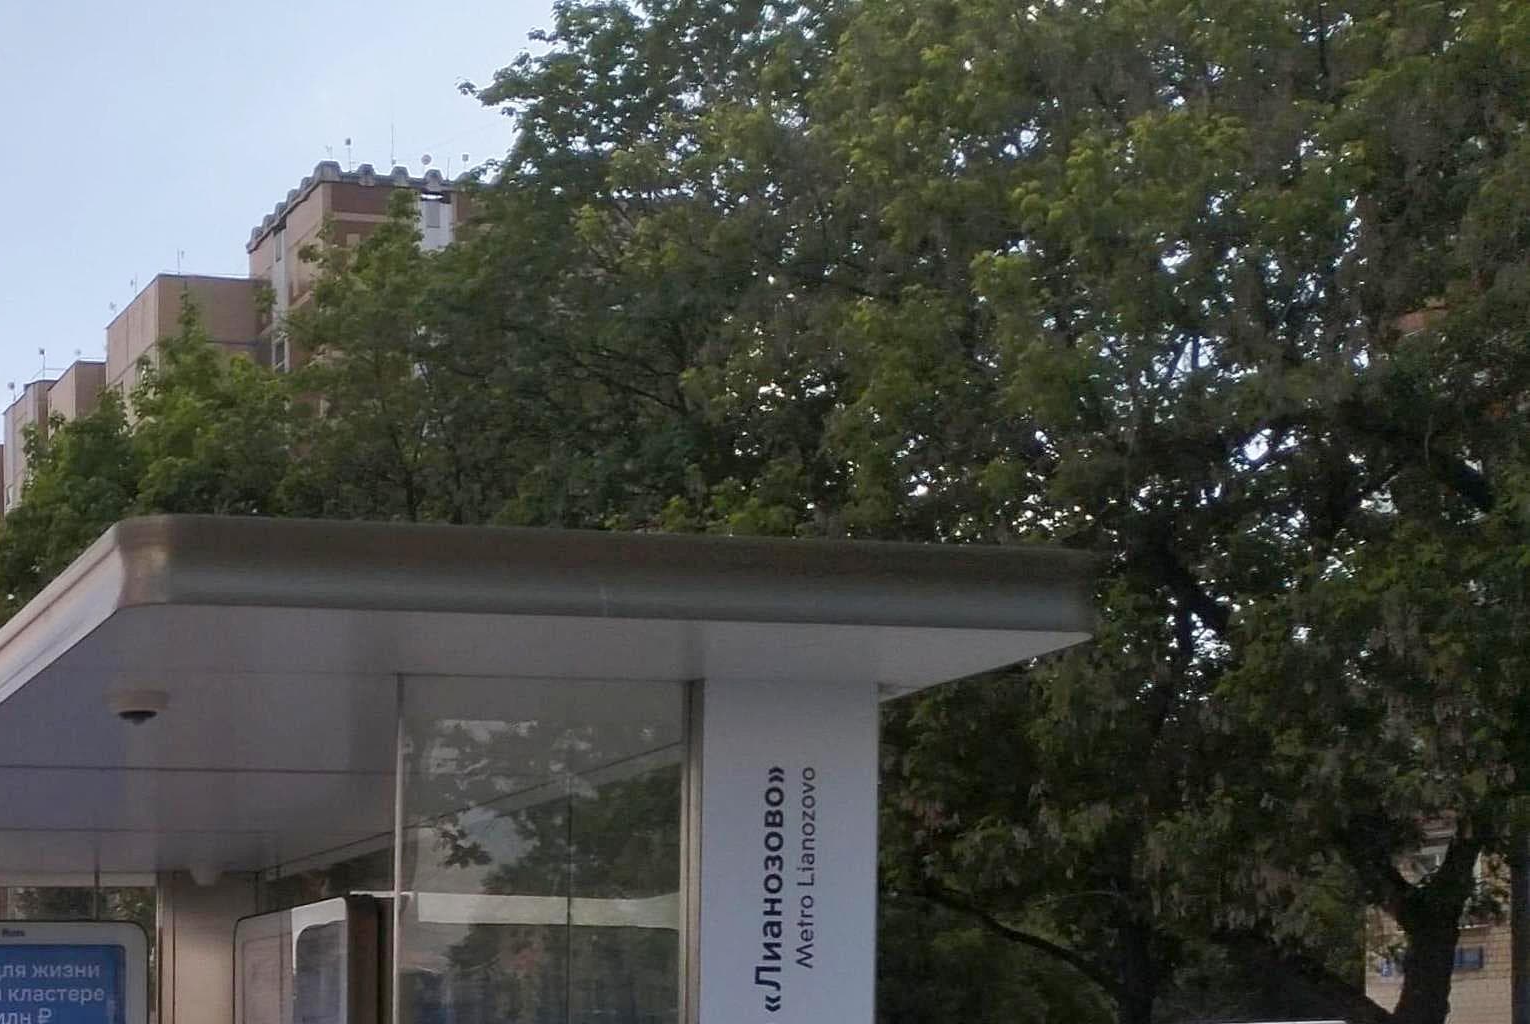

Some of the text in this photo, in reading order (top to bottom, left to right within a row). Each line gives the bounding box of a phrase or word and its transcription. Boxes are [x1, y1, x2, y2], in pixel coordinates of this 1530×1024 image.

[754, 766, 785, 1013] «Лианозово»
[795, 766, 816, 969] Metro Lianozovo
[8, 987, 105, 1006] кластере
[31, 963, 101, 979] жизни
